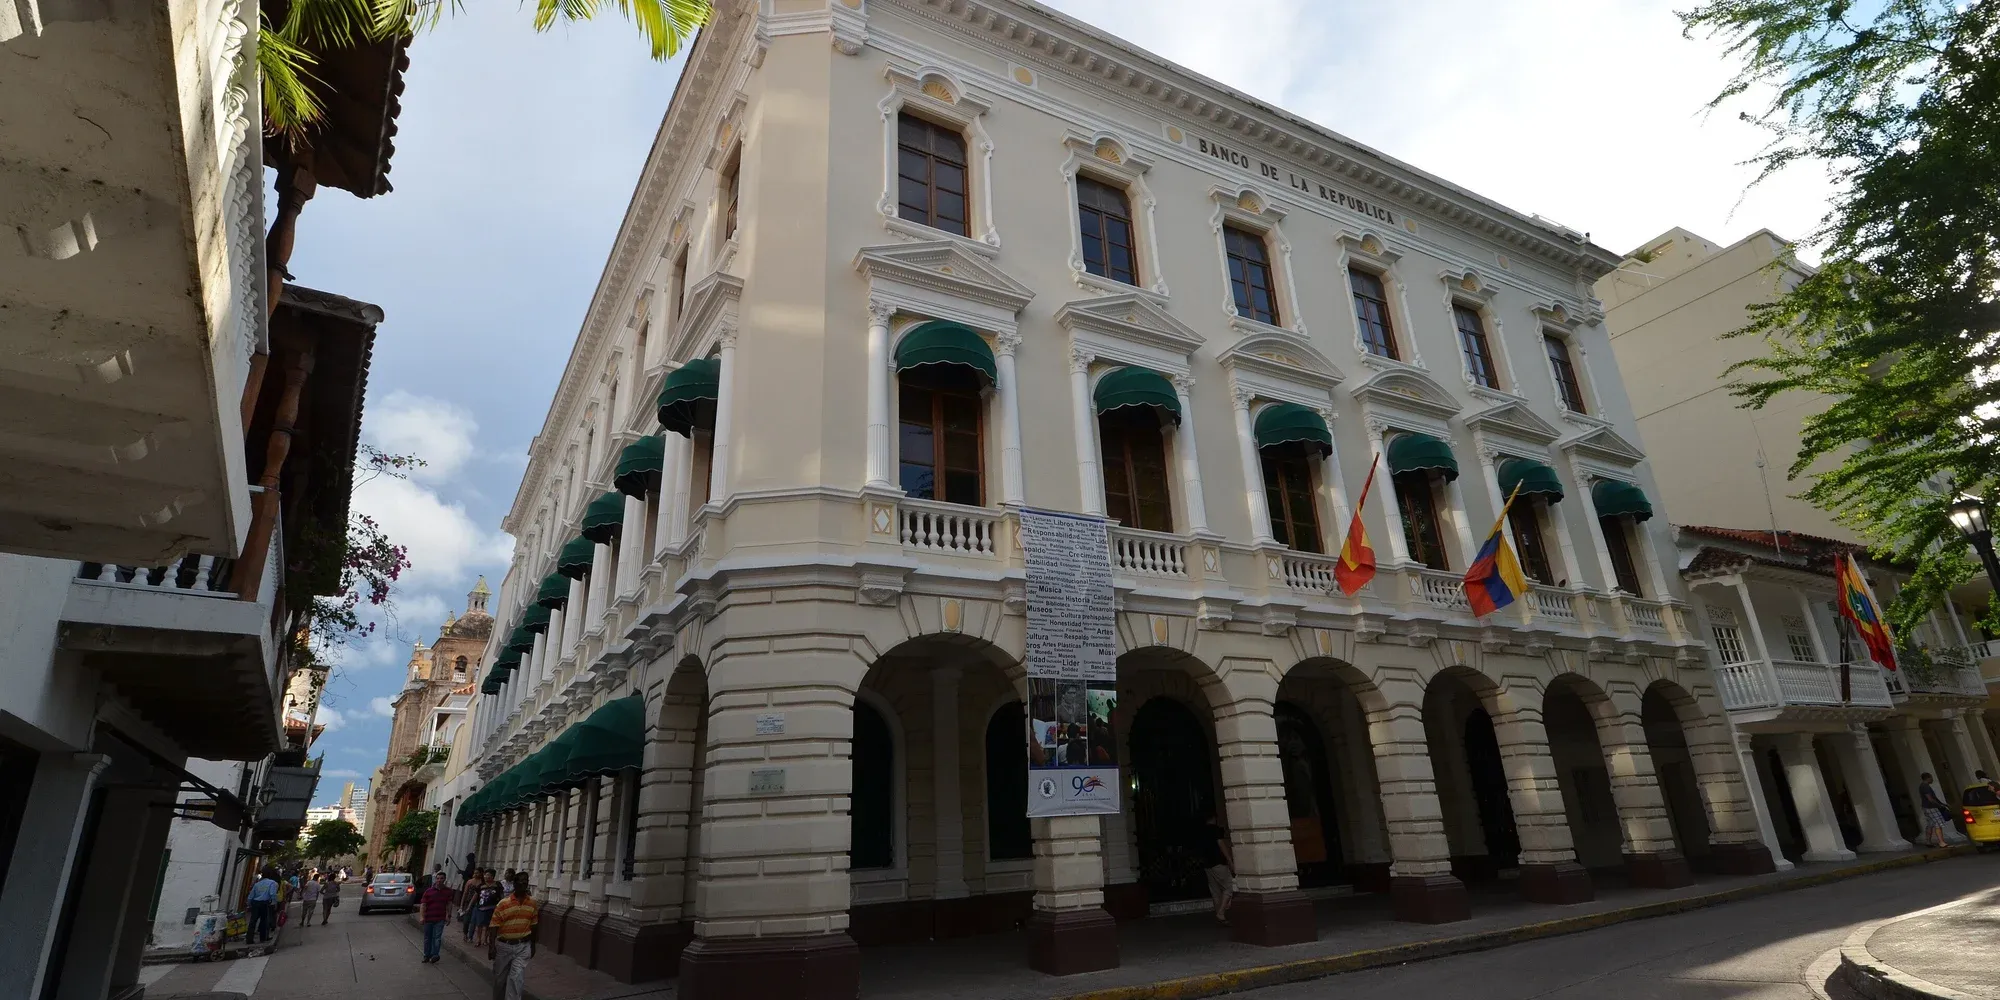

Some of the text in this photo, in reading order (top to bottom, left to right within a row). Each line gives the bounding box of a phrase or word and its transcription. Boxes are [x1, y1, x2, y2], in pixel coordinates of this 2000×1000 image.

[1199, 138, 1395, 225] BANCO DE LA REPUBLICA
[1053, 519, 1074, 528] Libros
[1027, 527, 1081, 540] Responsabilidad
[1068, 550, 1107, 561] Crecimiento
[1038, 585, 1062, 594] Música
[1065, 595, 1090, 604] Historia
[1093, 594, 1114, 602] Calidad
[1026, 605, 1053, 614] Museos
[1049, 619, 1082, 628] Honestidad
[1096, 628, 1114, 636] Artes
[1063, 633, 1090, 641] Respaldo
[1071, 776, 1095, 797] 90
